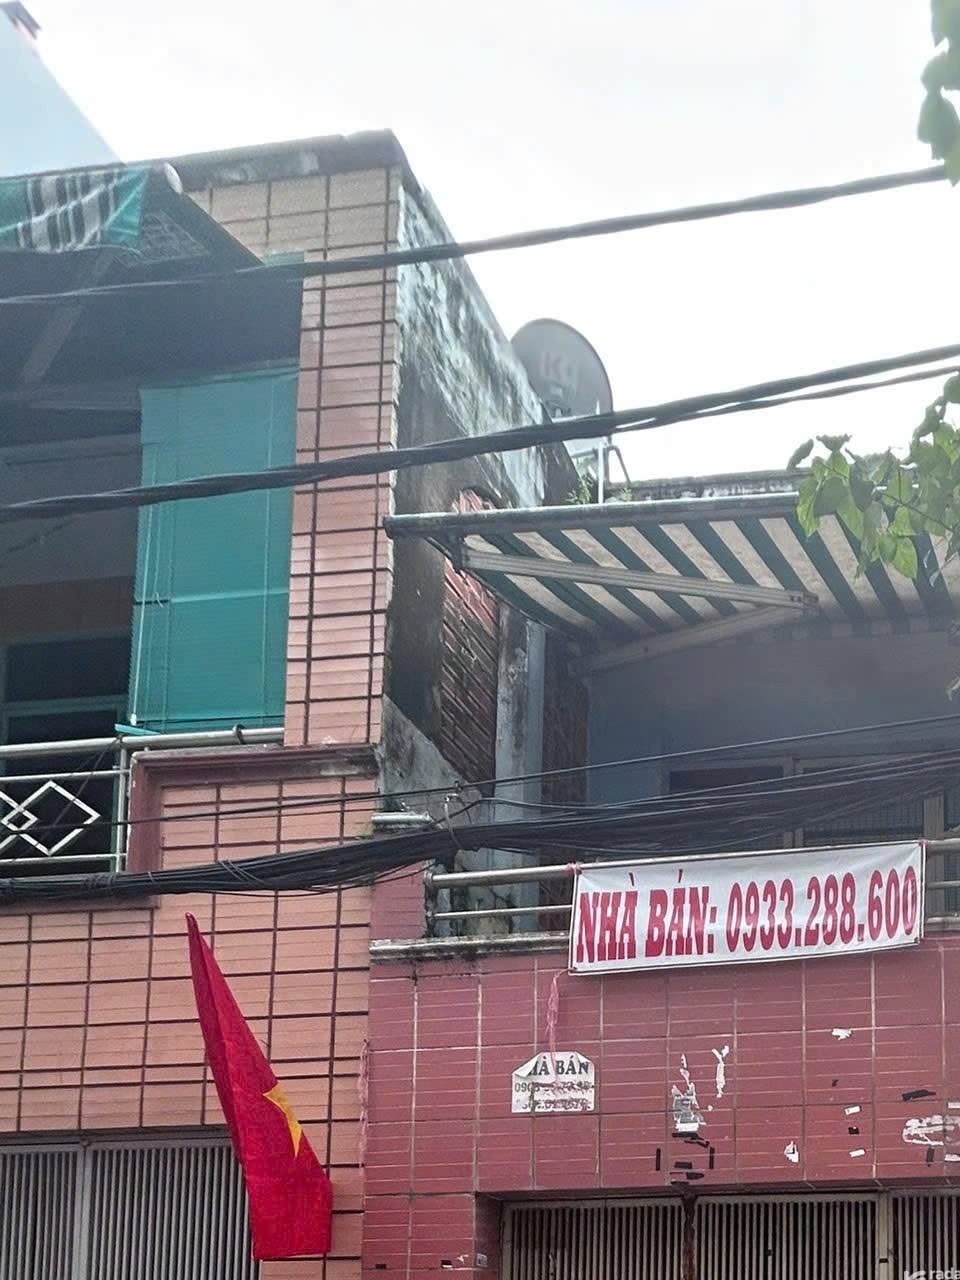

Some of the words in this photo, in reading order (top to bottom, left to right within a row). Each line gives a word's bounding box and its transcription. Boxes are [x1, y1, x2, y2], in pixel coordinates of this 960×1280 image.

[576, 872, 638, 963] NHÀ
[644, 869, 717, 957] BÁN:
[726, 865, 917, 952] 0933.288.600
[555, 1055, 590, 1075] BÁN
